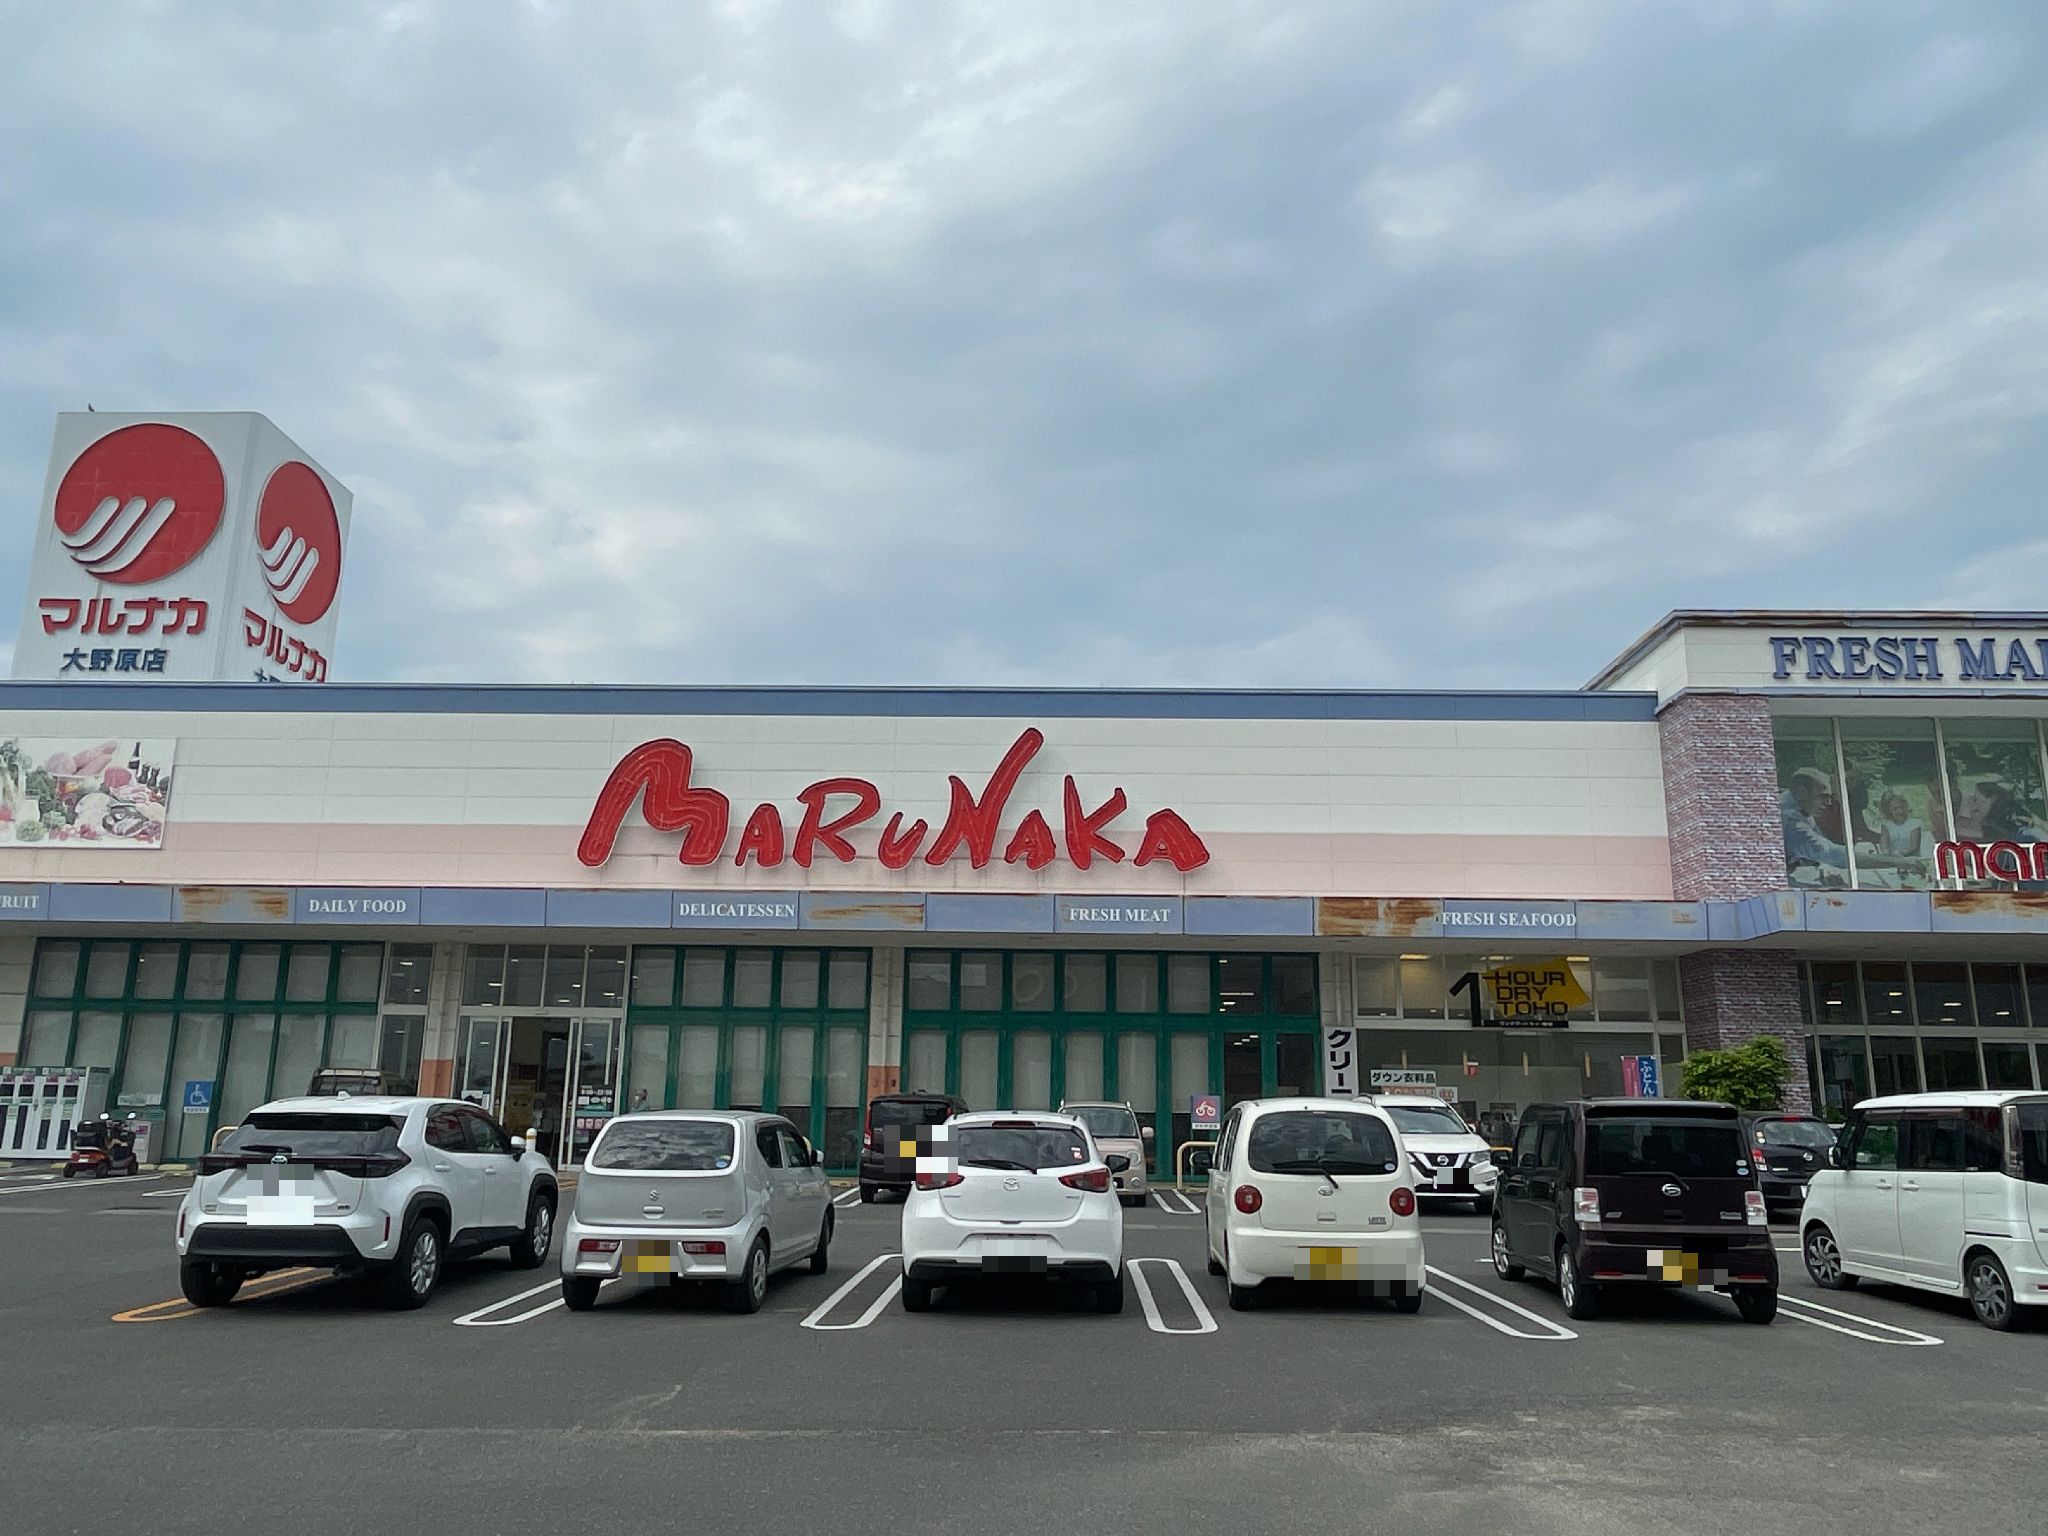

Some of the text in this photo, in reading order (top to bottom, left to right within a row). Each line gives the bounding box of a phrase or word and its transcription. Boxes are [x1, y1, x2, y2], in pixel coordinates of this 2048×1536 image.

[38, 596, 208, 636] マルナカ
[243, 608, 328, 684] マルナカ
[61, 647, 169, 674] 大野原店
[1770, 636, 1944, 680] FRESH
[0, 895, 40, 909] RUIT
[309, 899, 406, 914] DAILY FOOD
[679, 902, 796, 918] DELICATESSEN
[1069, 907, 1170, 923] FRESH MEAT
[1442, 911, 1576, 927] FRESH SEAFOOD
[1496, 986, 1549, 1001] DRY
[1496, 1001, 1568, 1016] TOHO
[1372, 1072, 1436, 1083] ダウン衣料品
[1641, 1060, 1655, 1097] ふとん
